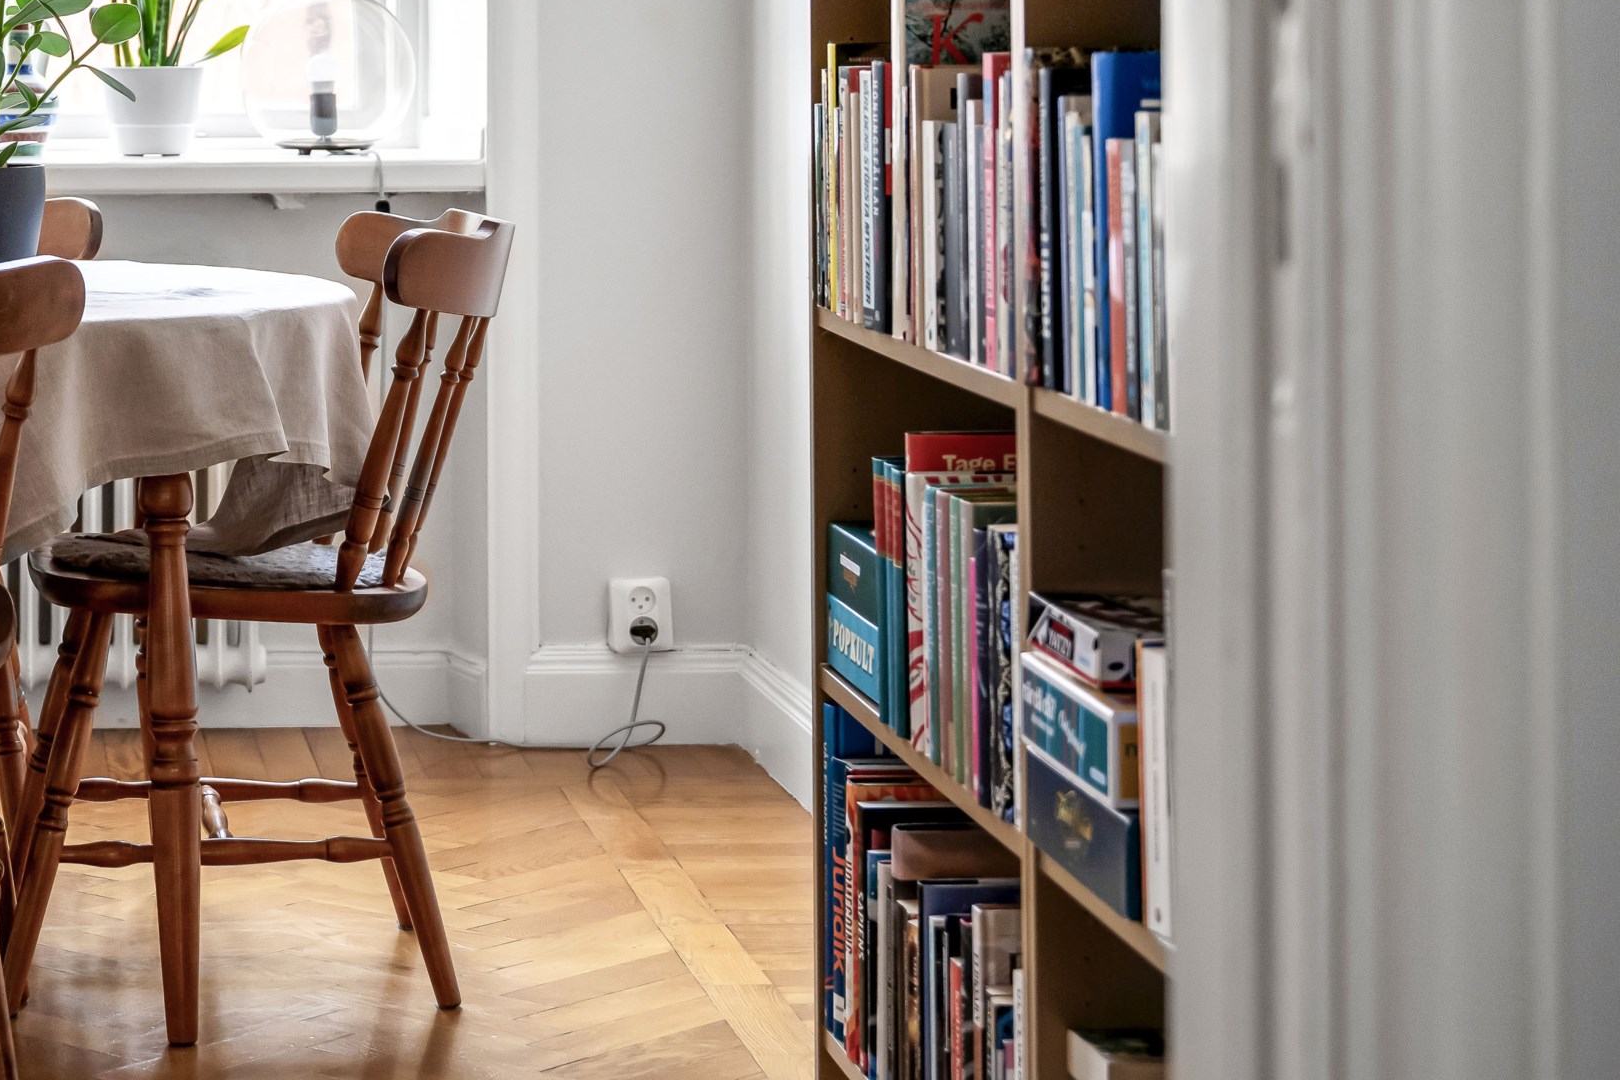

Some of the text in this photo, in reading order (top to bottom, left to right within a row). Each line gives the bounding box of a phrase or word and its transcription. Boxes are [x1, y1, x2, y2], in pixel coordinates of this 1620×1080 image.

[941, 453, 996, 472] Tage
[833, 618, 875, 676] POPKULT
[832, 846, 845, 975] Juridik
